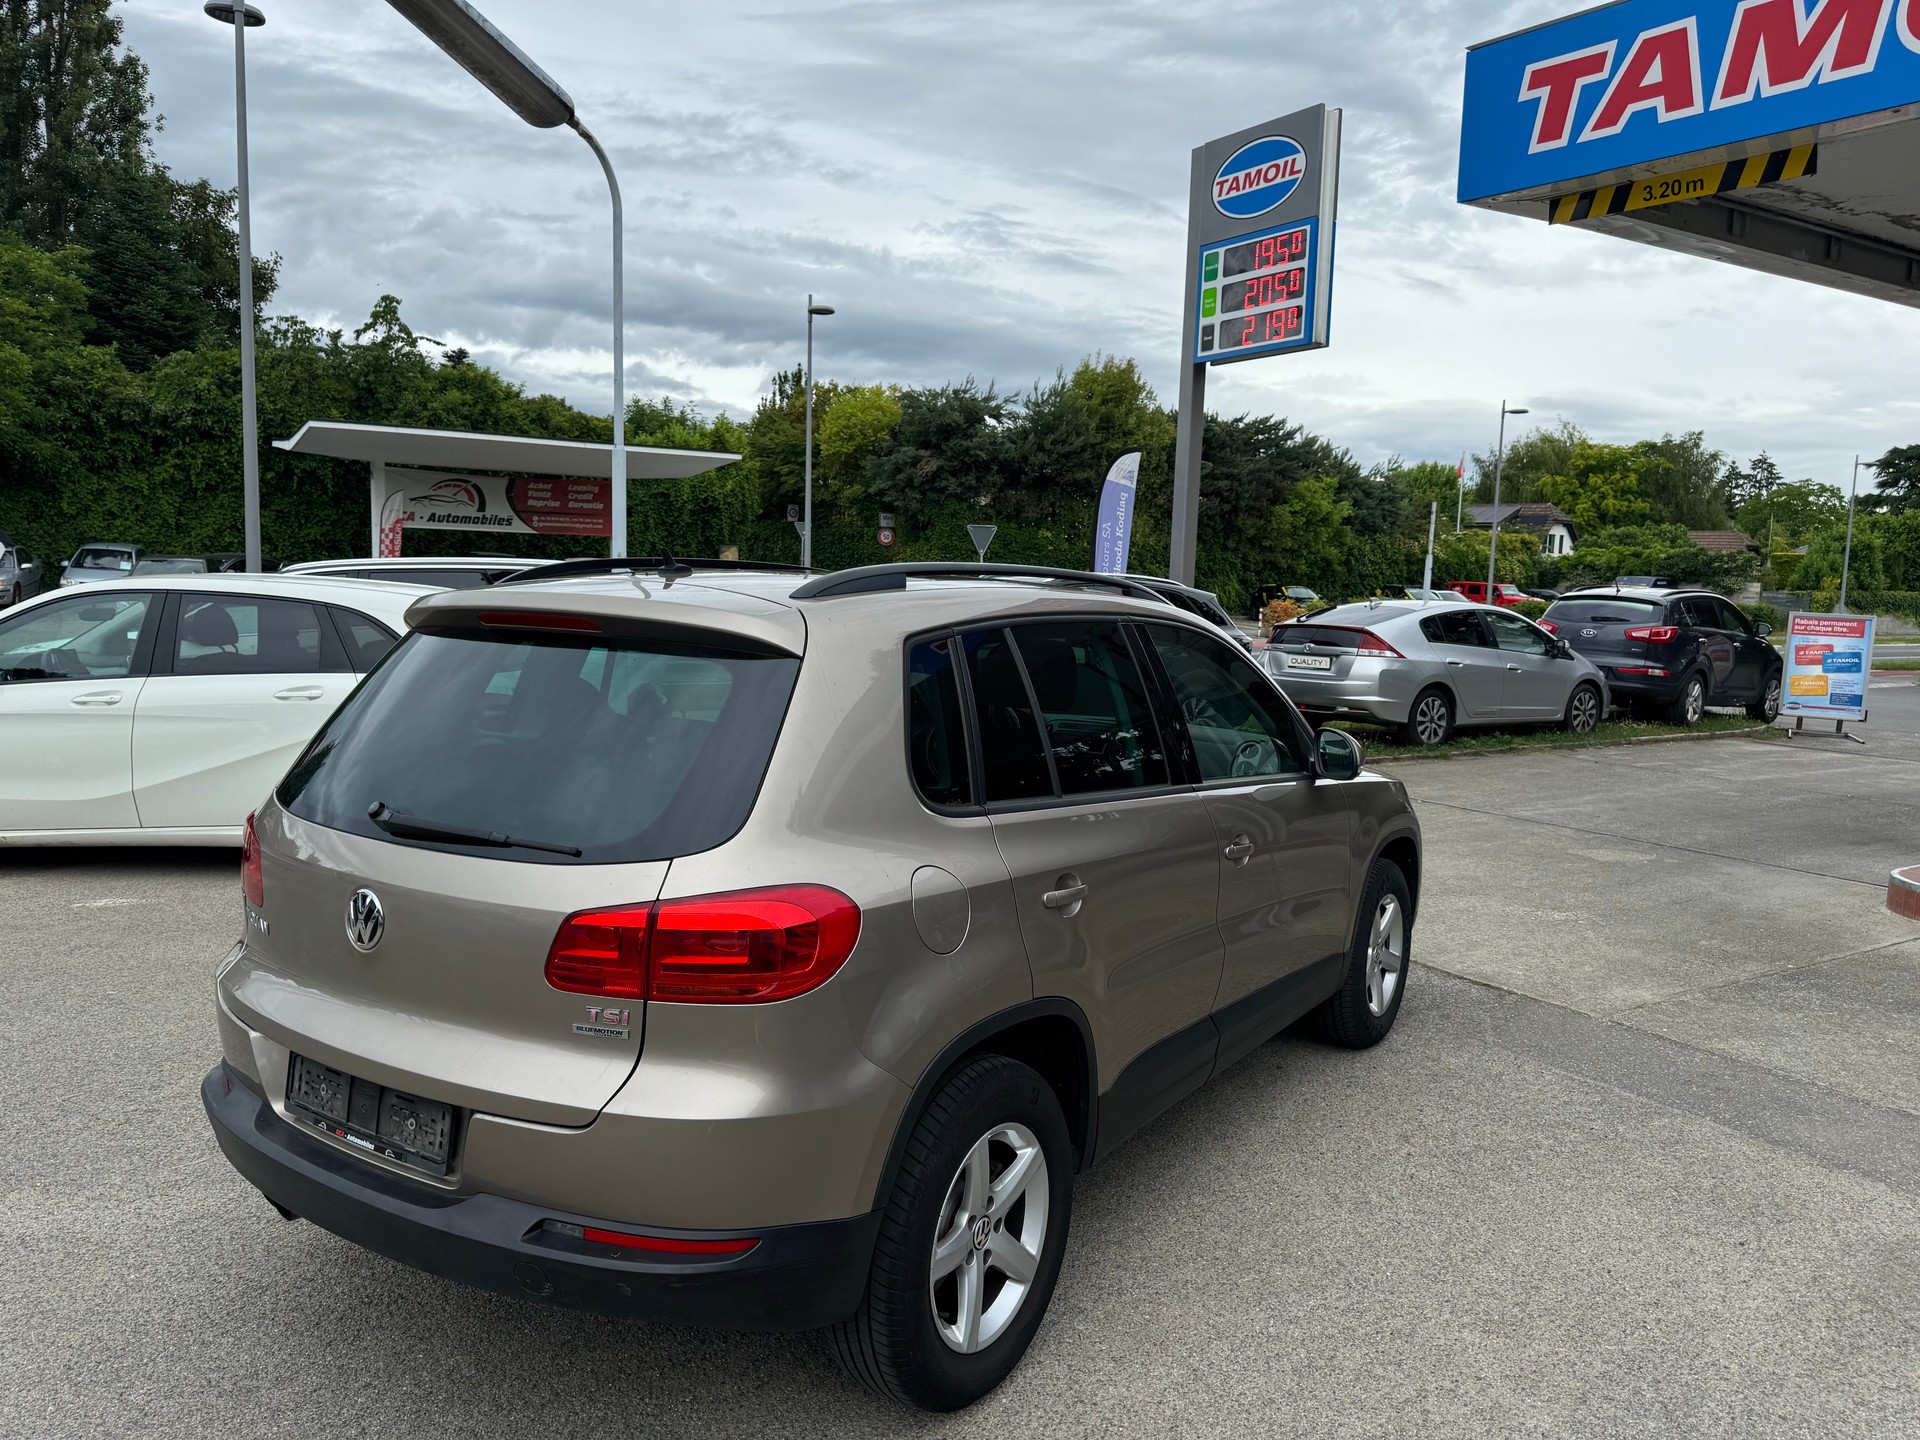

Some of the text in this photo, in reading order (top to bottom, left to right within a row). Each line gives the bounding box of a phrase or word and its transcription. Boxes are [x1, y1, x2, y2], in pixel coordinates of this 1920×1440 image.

[1518, 0, 1920, 154] TAM
[1216, 157, 1303, 199] TAMOIL
[1642, 178, 1705, 203] 3.20 m
[527, 490, 552, 498] Vente
[528, 482, 552, 490] Achat
[568, 484, 599, 493] Leasing
[527, 499, 561, 507] Reprise
[568, 501, 604, 510] Garantie
[427, 512, 513, 526] Automobiles
[1102, 522, 1111, 539] SA
[1113, 492, 1129, 574] koda Kodiaq
[394, 523, 402, 556] ASSION
[586, 1005, 630, 1026] TSI
